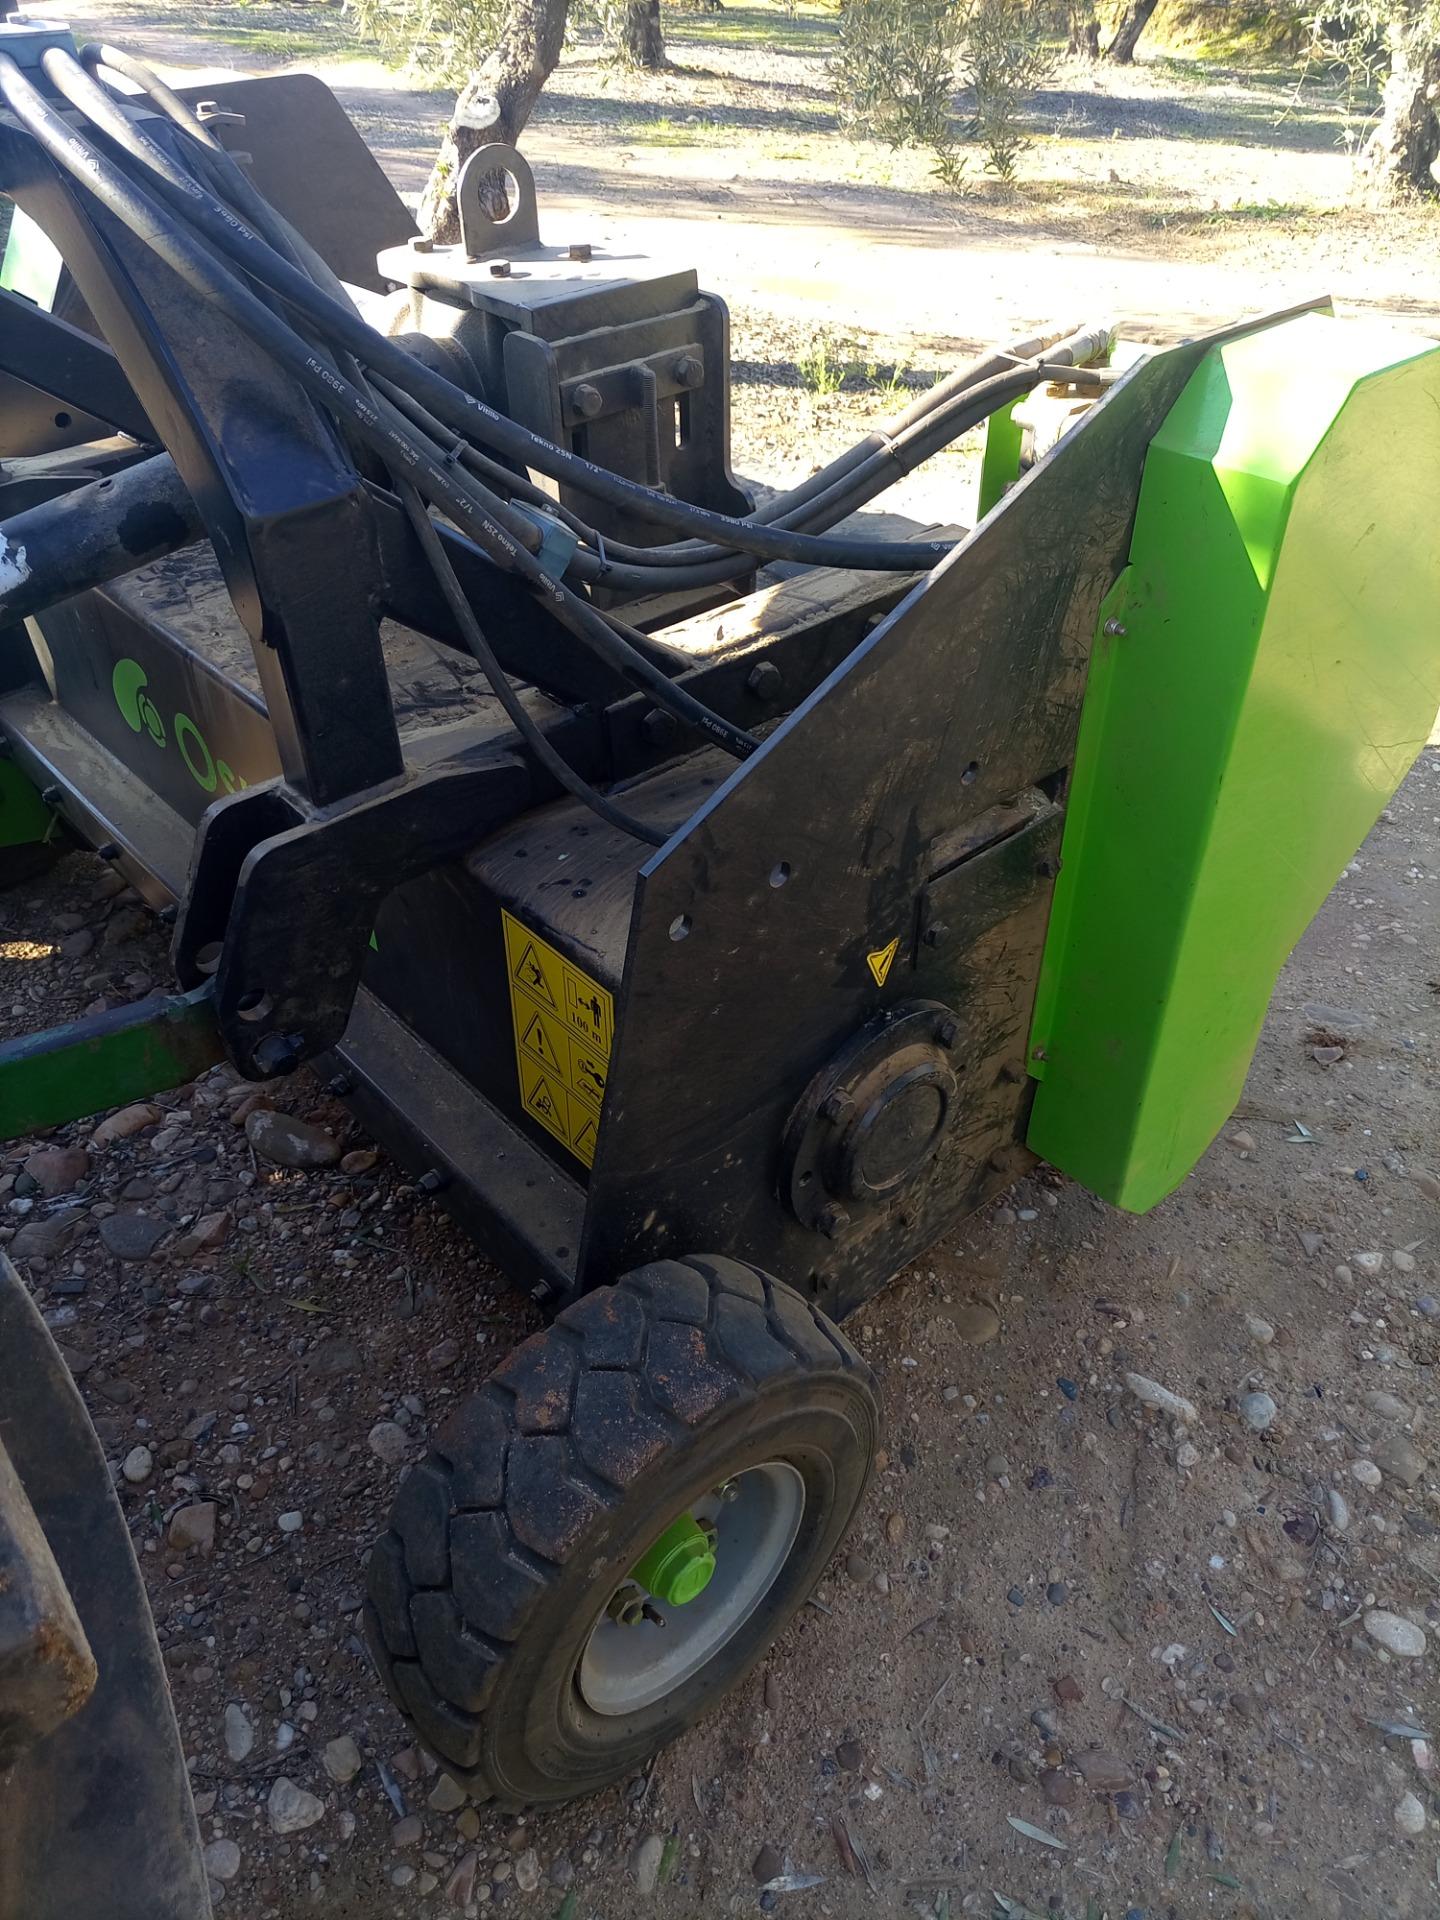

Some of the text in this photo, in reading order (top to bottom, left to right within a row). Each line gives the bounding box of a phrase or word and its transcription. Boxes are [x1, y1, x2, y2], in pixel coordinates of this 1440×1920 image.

[213, 206, 239, 228] 3980
[237, 225, 254, 240] Psi
[305, 356, 322, 373] Psi
[321, 370, 346, 394] 3980
[477, 402, 499, 421] Vitillo
[529, 433, 554, 451] Tekno
[555, 446, 573, 460] 2SN
[481, 519, 498, 537] 2SN
[497, 533, 518, 557] Tekno
[539, 572, 556, 593] Vitillo
[572, 1011, 602, 1044] 100 m
